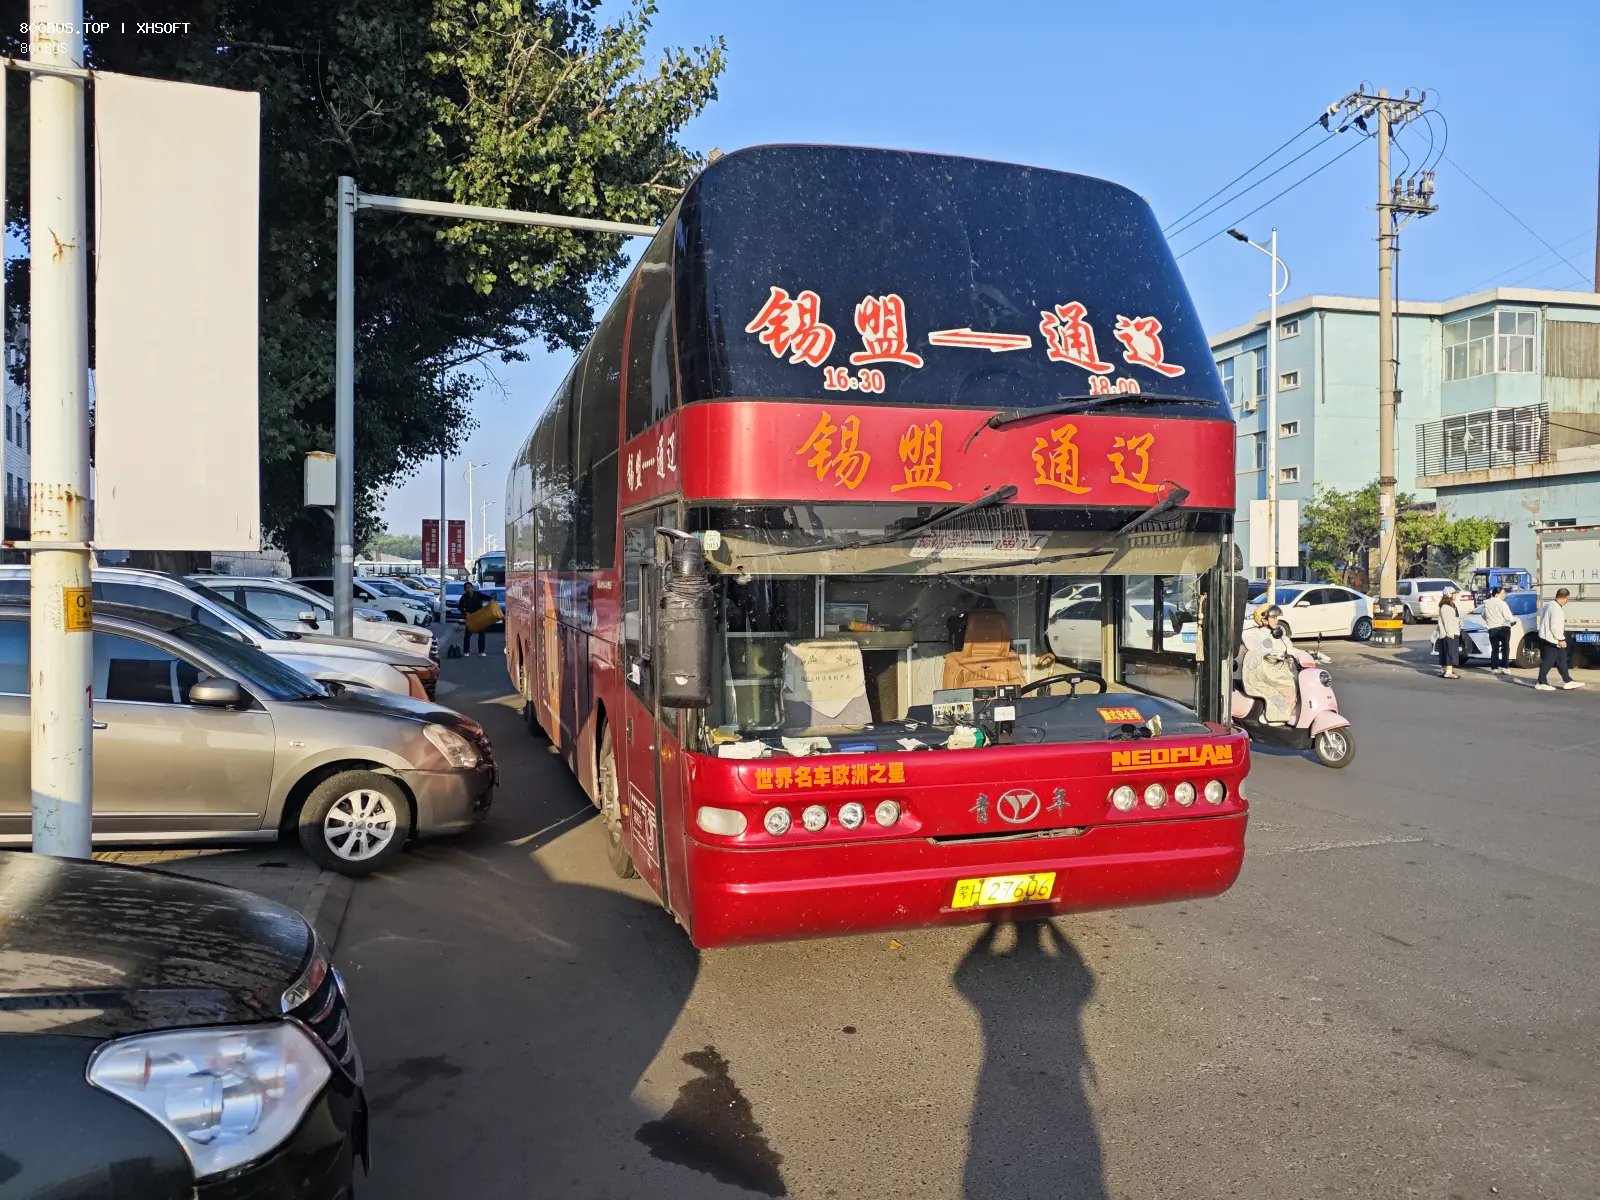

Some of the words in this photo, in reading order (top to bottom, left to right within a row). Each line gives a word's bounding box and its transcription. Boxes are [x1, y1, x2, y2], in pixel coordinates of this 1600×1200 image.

[745, 286, 923, 368] 锡盟
[1040, 301, 1185, 377] 通辽
[824, 366, 886, 394] 16:30
[797, 411, 953, 492] 锡盟
[1032, 423, 1166, 494] 通辽
[1111, 744, 1233, 770] NEOPLAN
[754, 762, 906, 790] 世界名车欧洲之星
